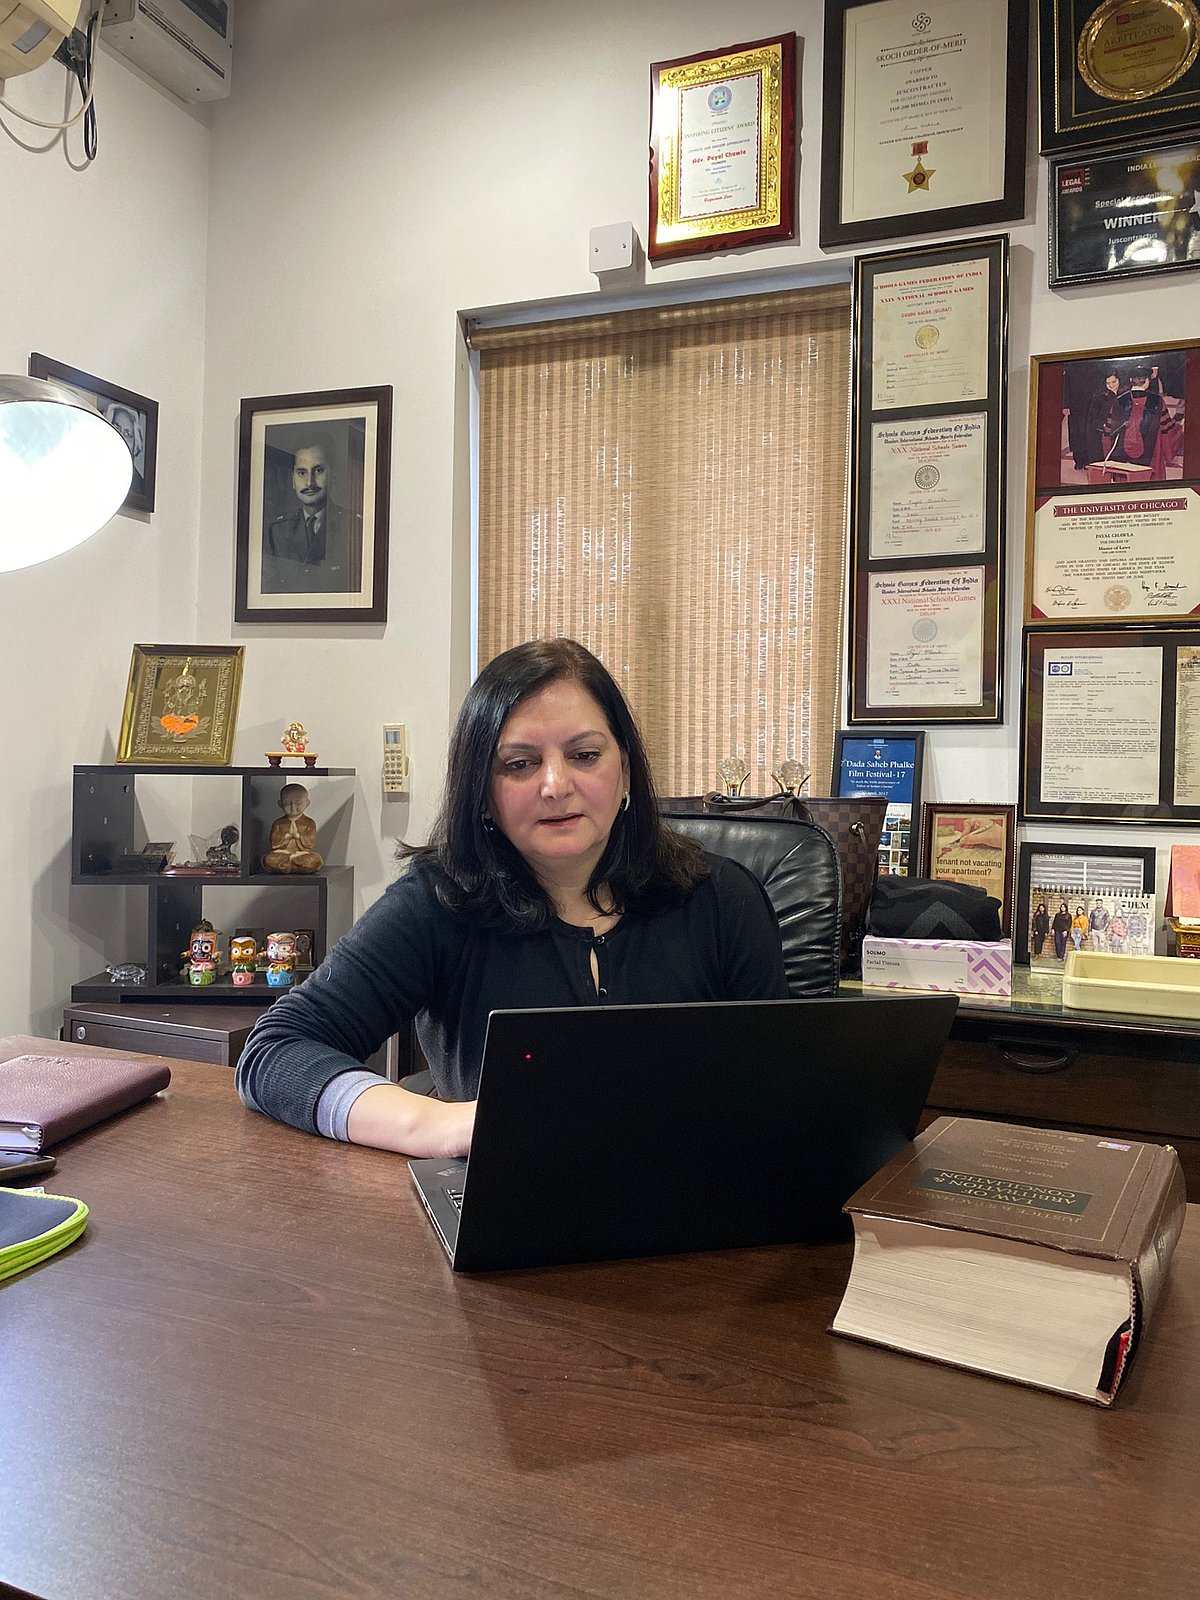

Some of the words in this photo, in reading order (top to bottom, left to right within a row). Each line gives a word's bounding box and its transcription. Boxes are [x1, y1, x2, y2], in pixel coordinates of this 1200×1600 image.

[1103, 24, 1174, 47] ARBITRATION
[876, 52, 902, 63] SKOCH
[902, 38, 968, 58] ORDER-OF-MERIT
[905, 76, 930, 84] AWARDED
[684, 130, 710, 139] INSPIRING
[737, 121, 755, 129] AWARD
[707, 153, 724, 161] Payal
[725, 149, 747, 158] Chawla
[1127, 164, 1148, 172] INDIA
[1062, 177, 1082, 187] LEGAL
[1061, 186, 1083, 195] AWARDS
[1104, 212, 1161, 230] WINNER
[1108, 232, 1158, 245] Juscontractus
[919, 276, 955, 285] FEDERATION
[922, 427, 952, 435] Federation
[954, 424, 963, 432] Of
[1080, 504, 1126, 513] UNIVERSITY
[1140, 501, 1178, 510] CHICAGO
[874, 581, 896, 589] Schools
[920, 579, 950, 587] Federation
[951, 577, 961, 585] Of
[902, 597, 929, 605] National
[954, 594, 976, 602] Games
[890, 761, 915, 769] Phalke
[936, 857, 959, 865] Tenant
[973, 860, 1002, 868] vacating
[952, 868, 992, 876] apartment?
[939, 1171, 1076, 1199] CONCILIATION
[948, 1180, 1077, 1205] ARBITRATION
[961, 1189, 988, 1197] OF
[991, 1192, 1033, 1205] LAW
[1016, 1208, 1082, 1224] JUSTICE
